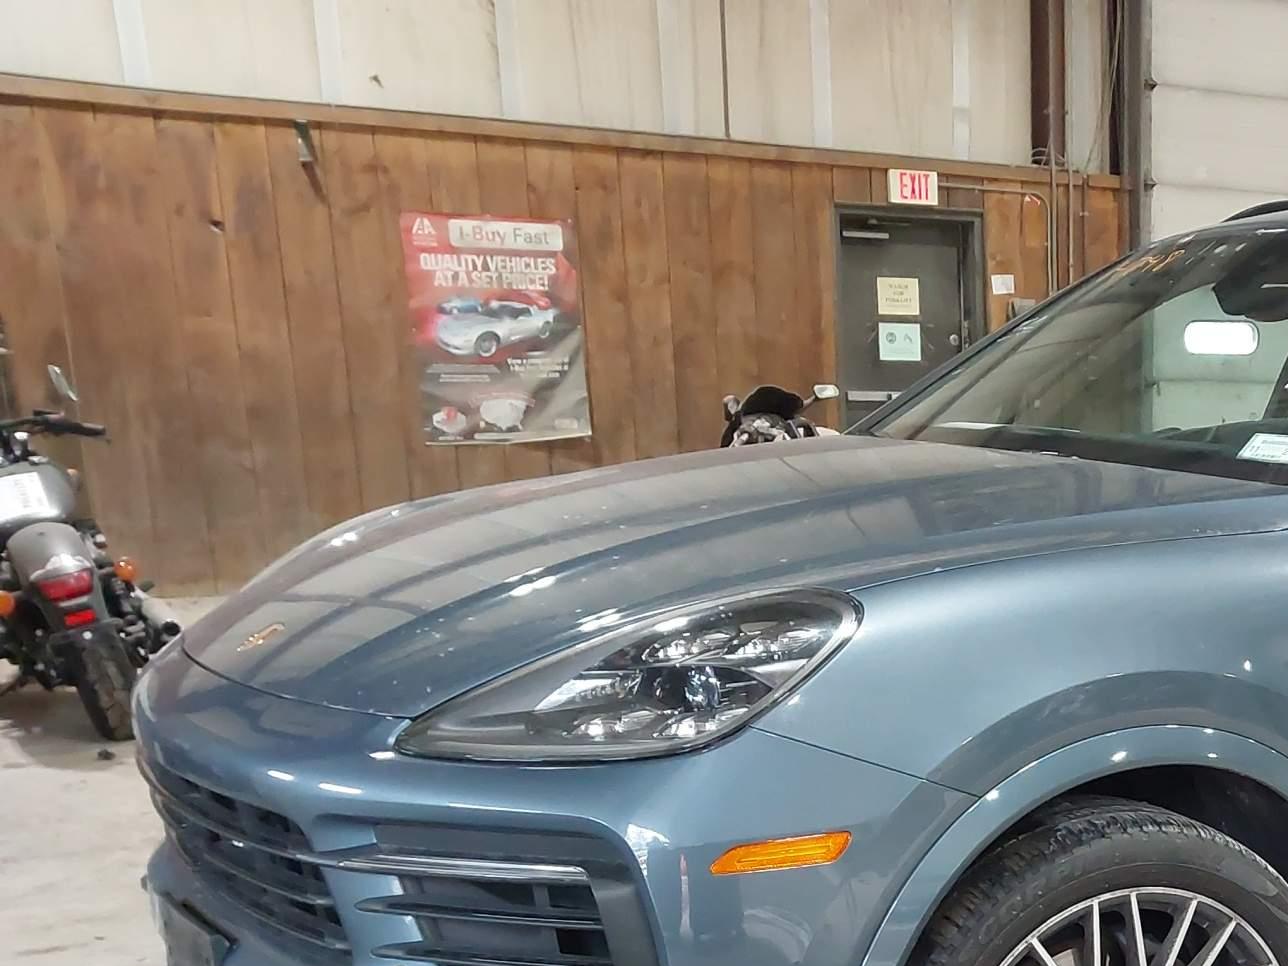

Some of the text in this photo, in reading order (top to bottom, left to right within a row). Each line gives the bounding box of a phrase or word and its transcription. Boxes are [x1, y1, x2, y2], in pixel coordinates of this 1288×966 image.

[900, 172, 930, 201] EXIT
[513, 227, 550, 246] Fast
[420, 252, 557, 275] QUALITY VEHICLES
[433, 271, 550, 291] AT A SET PRICE!
